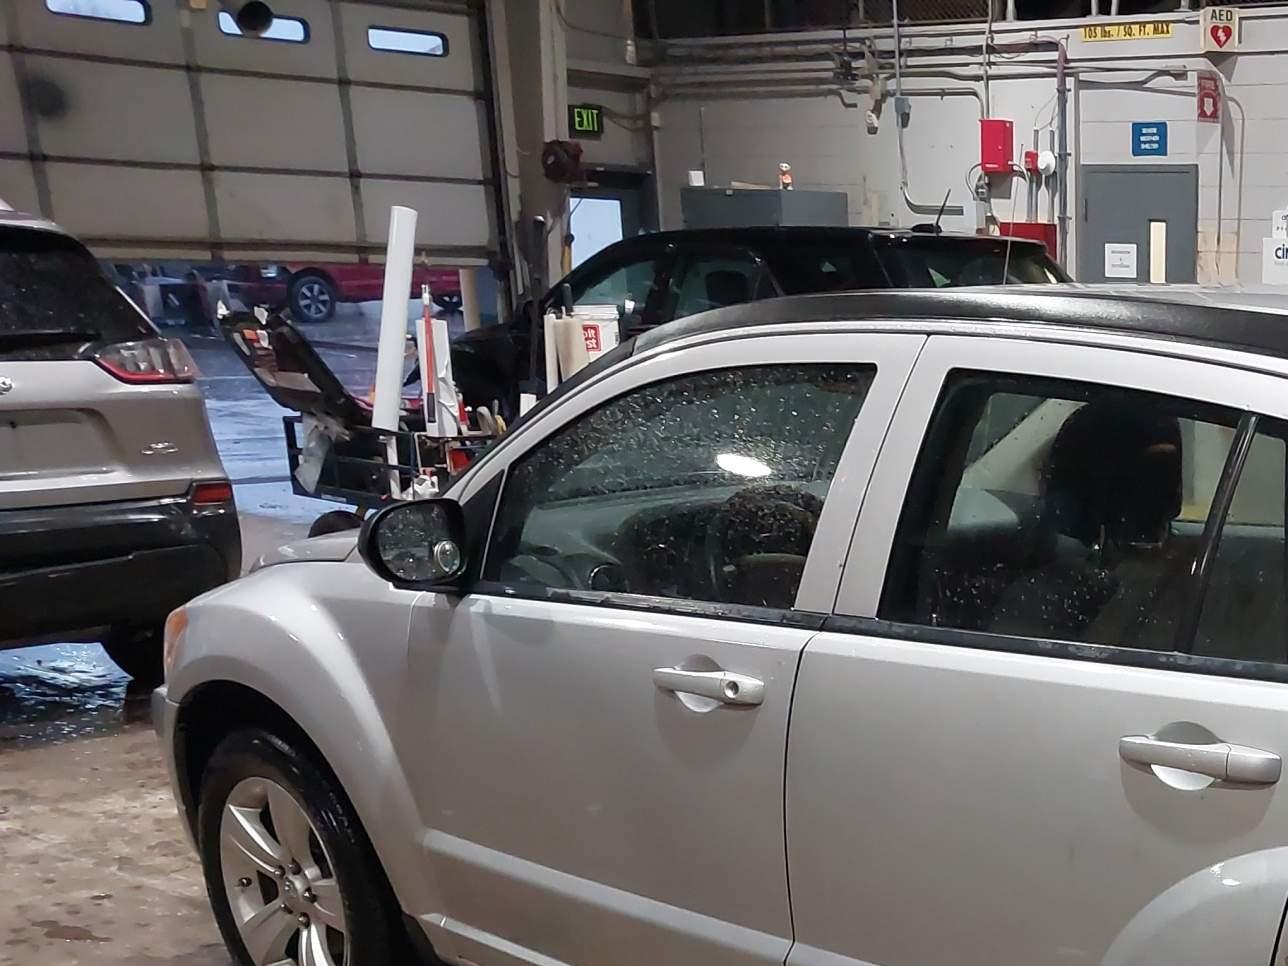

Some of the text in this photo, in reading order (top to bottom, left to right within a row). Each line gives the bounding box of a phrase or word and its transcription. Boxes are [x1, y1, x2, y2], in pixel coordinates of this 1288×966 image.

[1210, 9, 1233, 21] AED
[1153, 22, 1170, 35] MAX
[574, 108, 599, 131] EXIT
